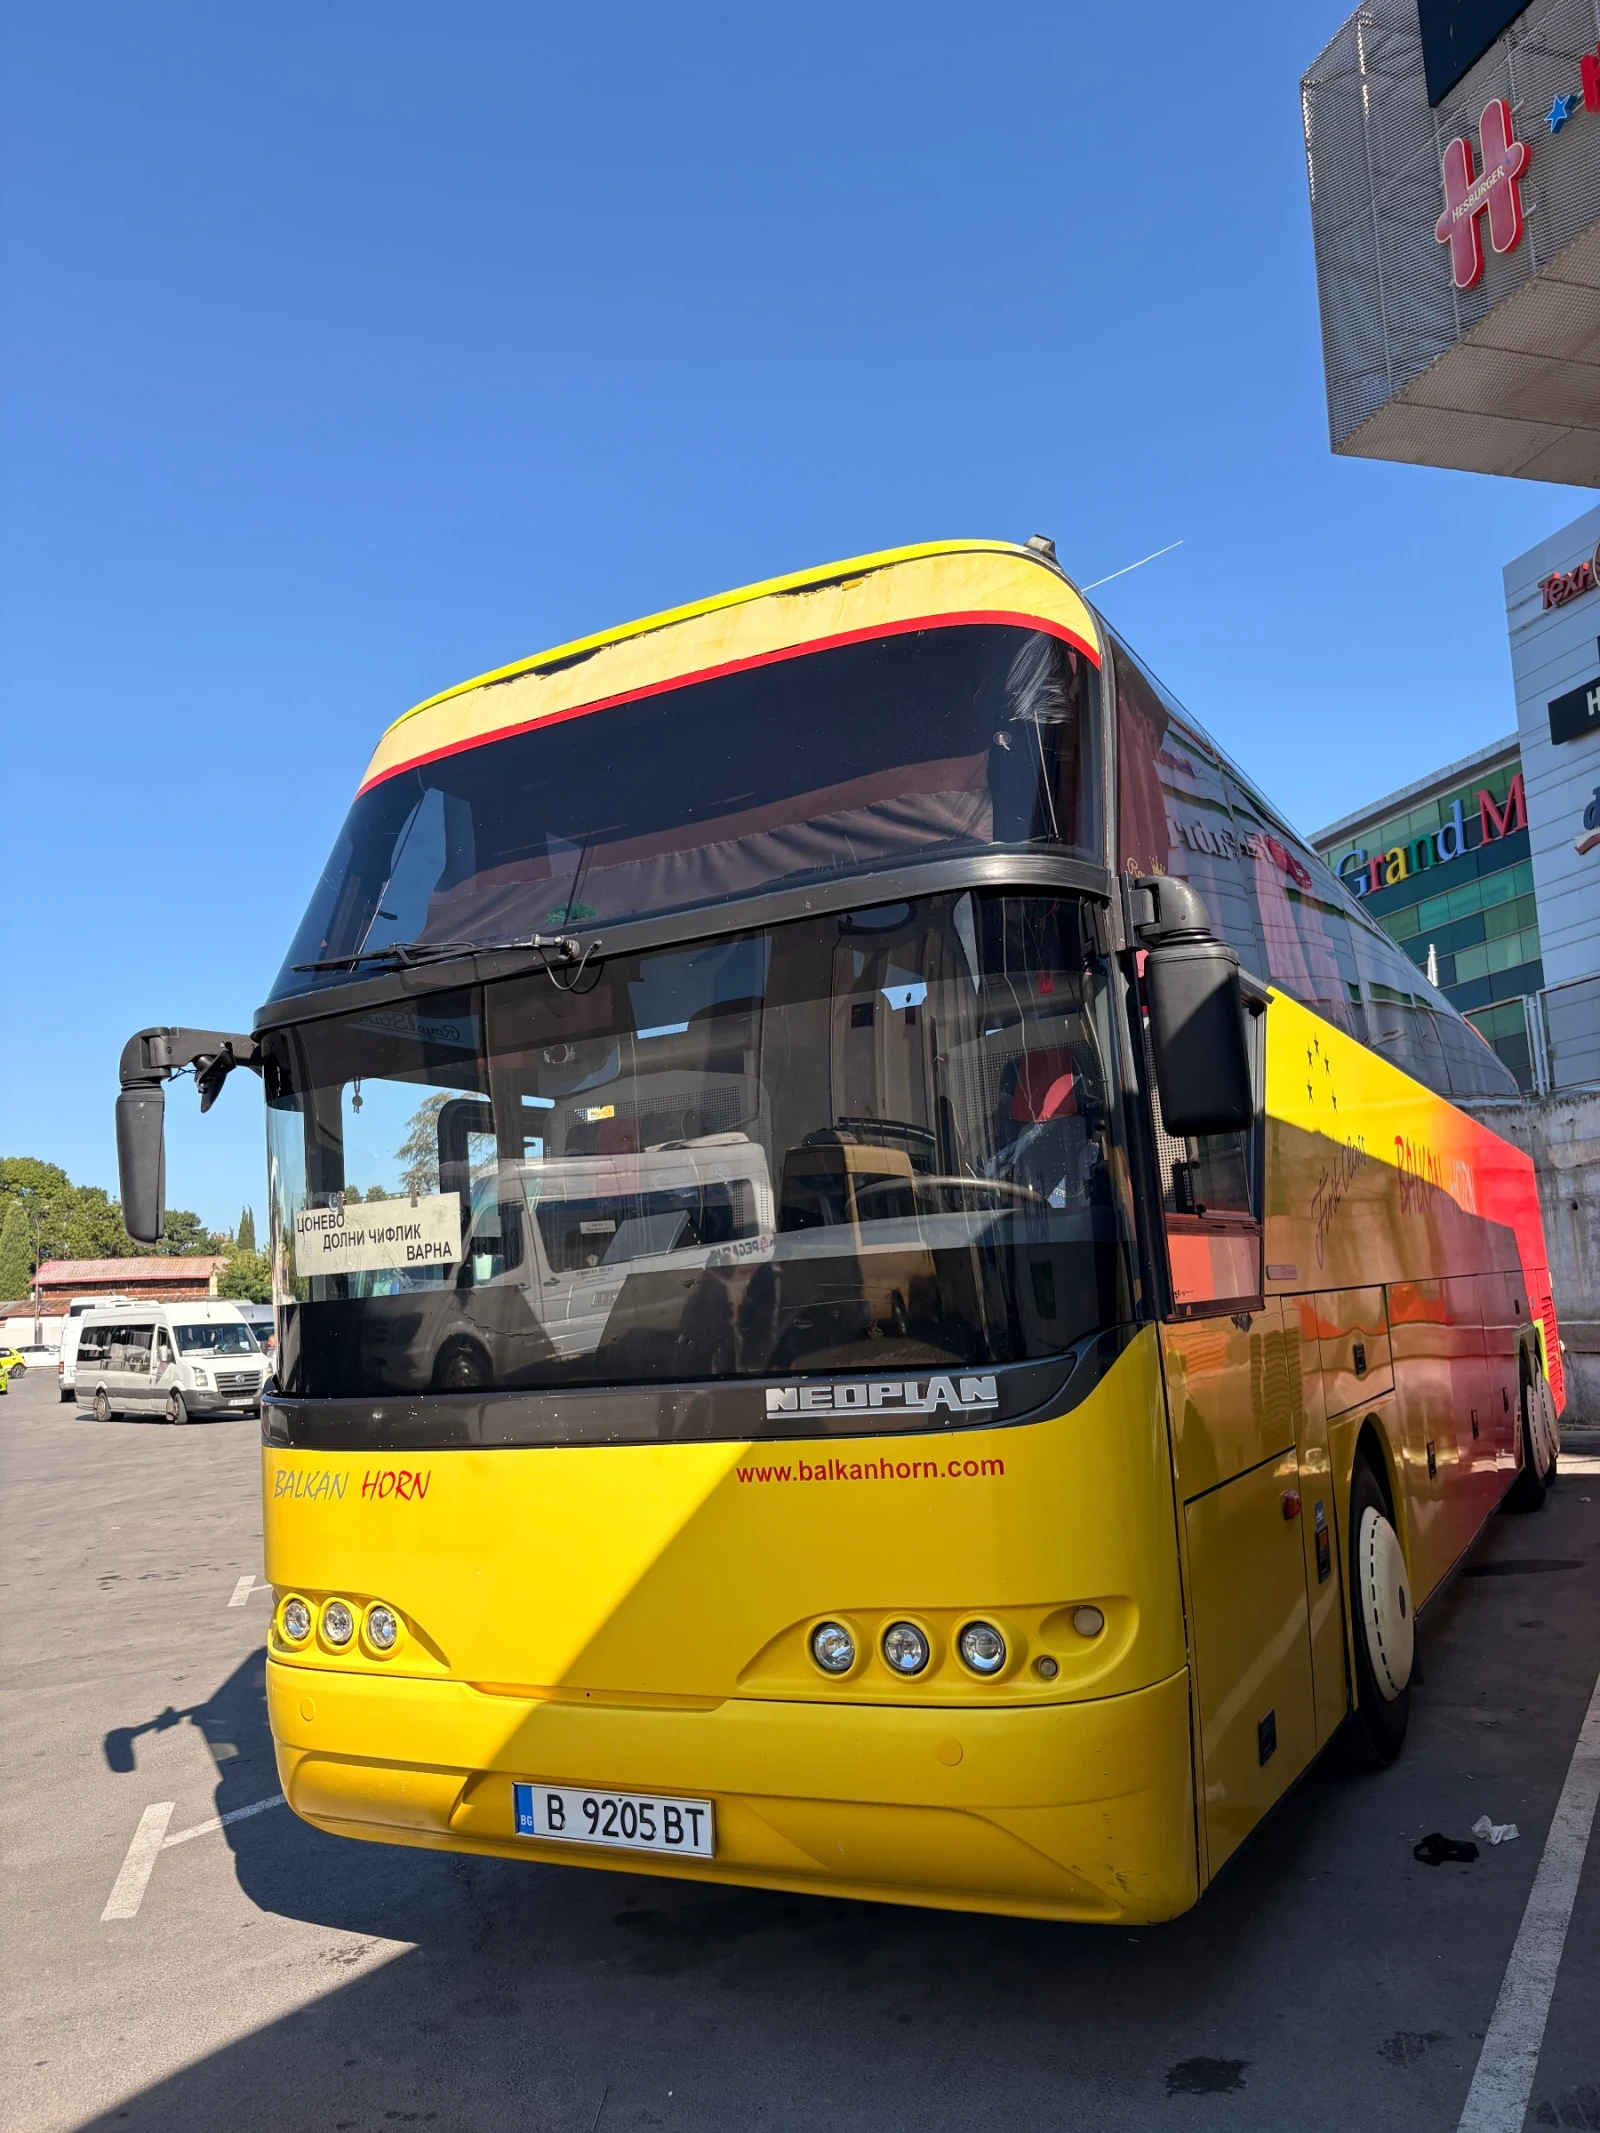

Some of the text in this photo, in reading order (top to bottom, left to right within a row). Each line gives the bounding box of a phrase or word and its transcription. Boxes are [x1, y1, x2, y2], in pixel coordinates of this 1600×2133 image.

[1452, 164, 1505, 223] HESBURGER
[1537, 558, 1596, 610] Техн
[1335, 799, 1468, 899] Grand
[297, 1213, 345, 1235] ЦОНЕВО
[323, 1223, 422, 1253] ДОЛНИ ЧИФЛИК
[406, 1240, 452, 1261] ВАРНА
[765, 1376, 999, 1414] NEOPLAN
[273, 1469, 432, 1501] BALKAN HORN
[735, 1457, 1005, 1483] www.balkanhorn.com
[520, 1815, 533, 1826] BG
[546, 1793, 705, 1847] B 9205 BT
